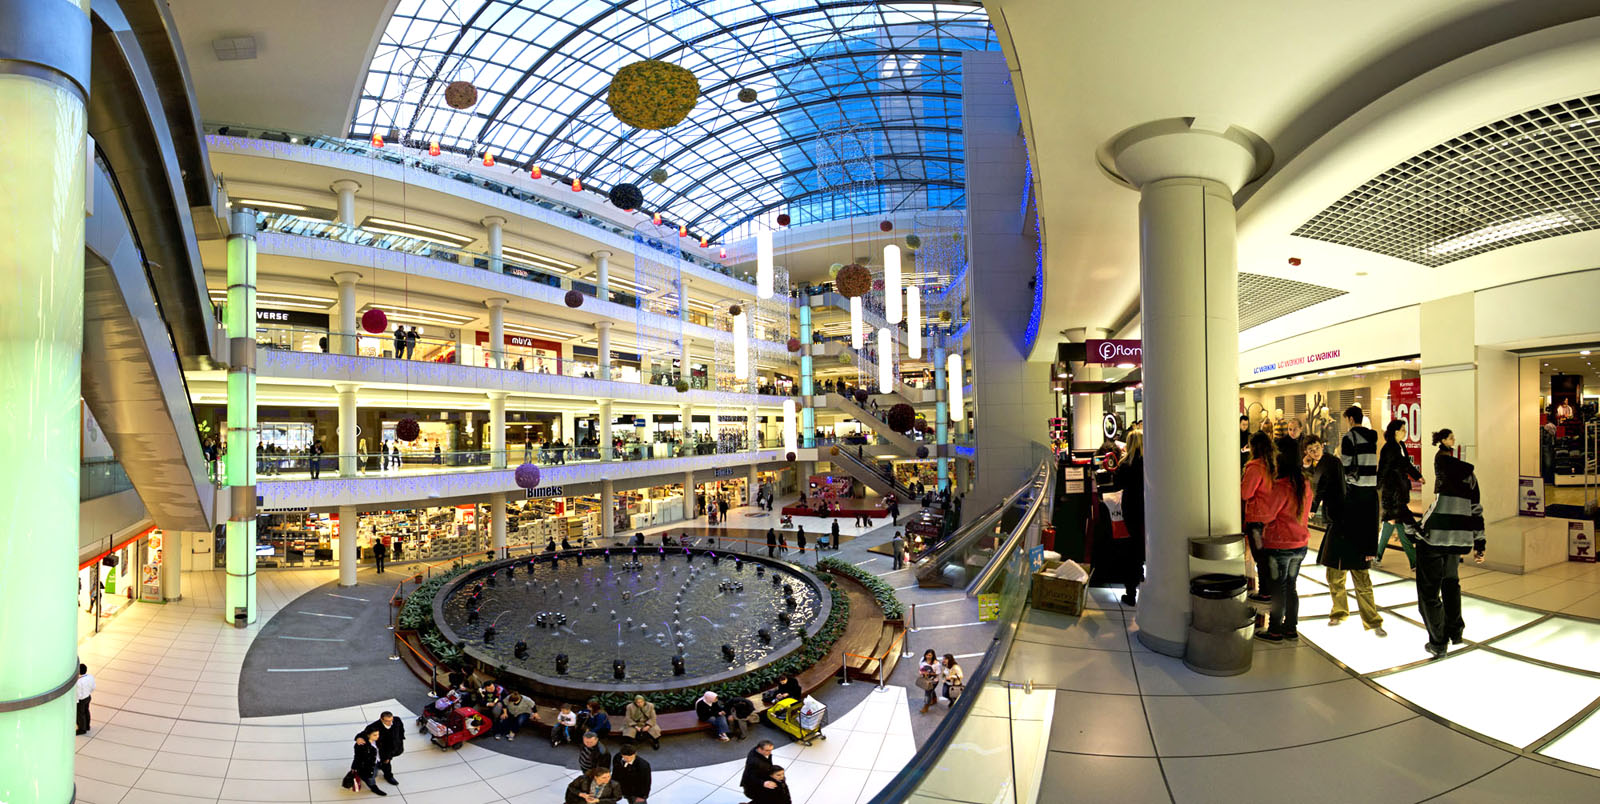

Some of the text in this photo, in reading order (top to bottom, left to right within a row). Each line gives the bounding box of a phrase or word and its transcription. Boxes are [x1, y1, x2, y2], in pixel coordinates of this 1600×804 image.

[256, 311, 289, 321] VERSE
[1307, 354, 1316, 363] LC
[527, 485, 563, 498] Bimeks
